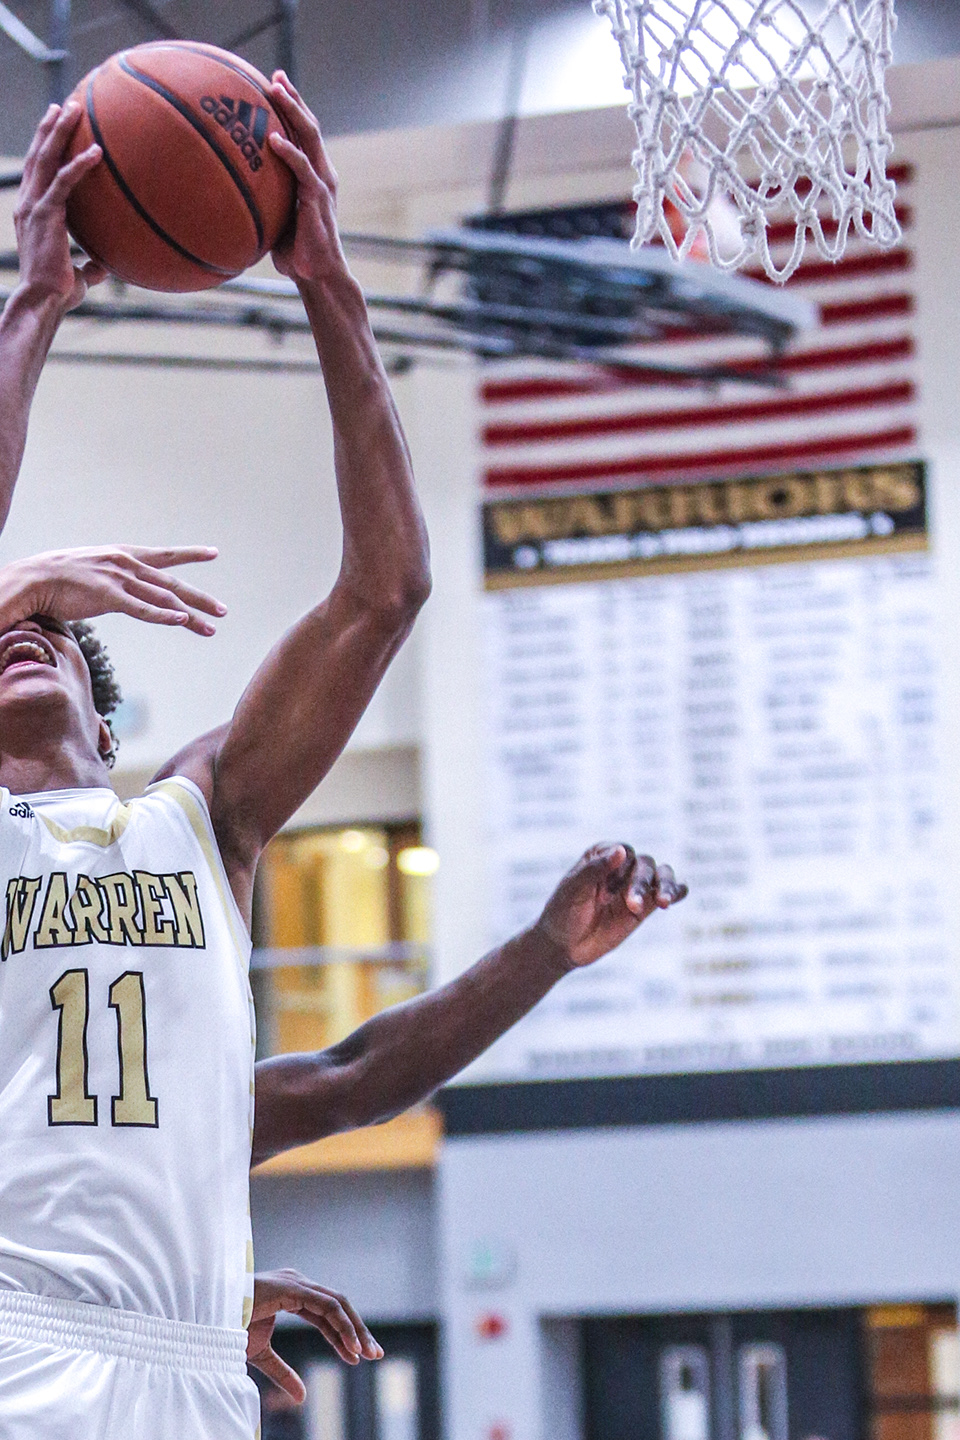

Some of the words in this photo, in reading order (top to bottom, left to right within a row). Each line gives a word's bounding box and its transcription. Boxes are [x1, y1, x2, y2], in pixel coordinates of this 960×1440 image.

[199, 95, 263, 173] adidas
[1, 869, 207, 962] WARREN
[47, 967, 159, 1129] 11
